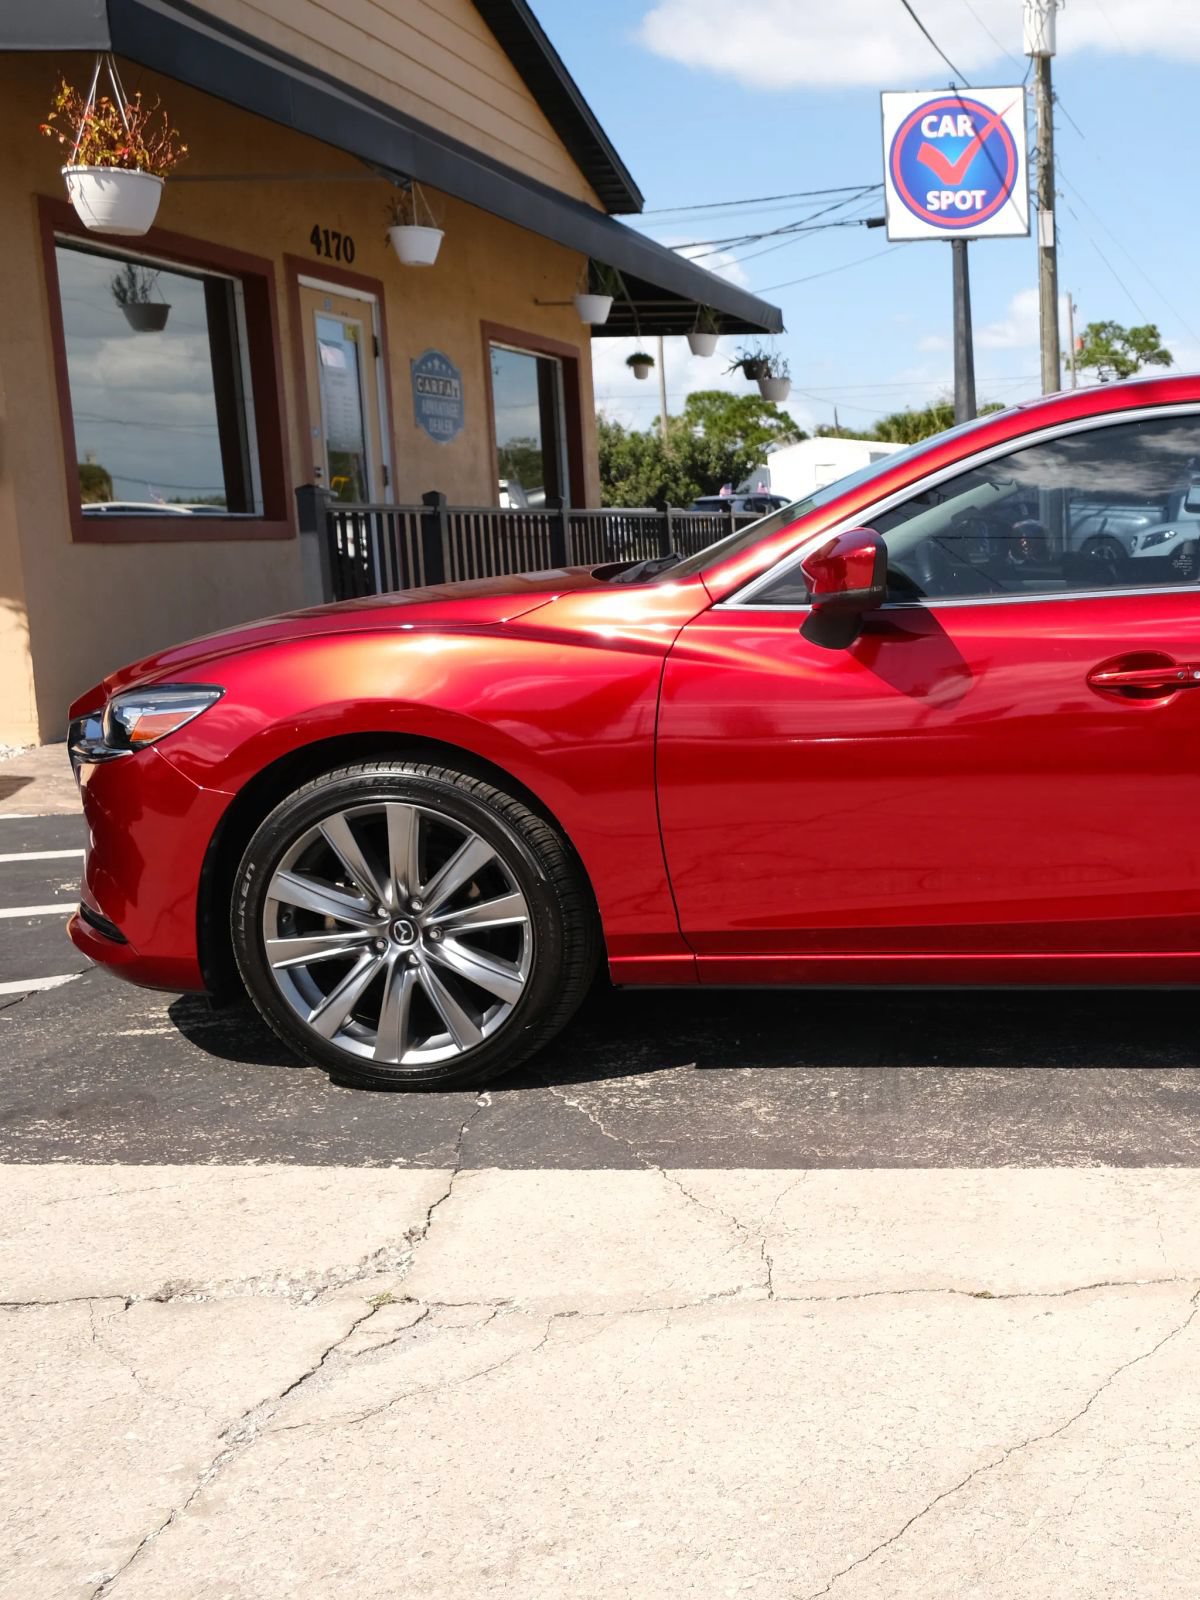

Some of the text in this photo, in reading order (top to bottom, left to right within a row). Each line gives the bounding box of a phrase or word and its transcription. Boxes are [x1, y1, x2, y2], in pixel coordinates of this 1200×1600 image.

[921, 115, 975, 139] CAR
[926, 190, 987, 211] SPOT
[310, 224, 355, 264] 4170
